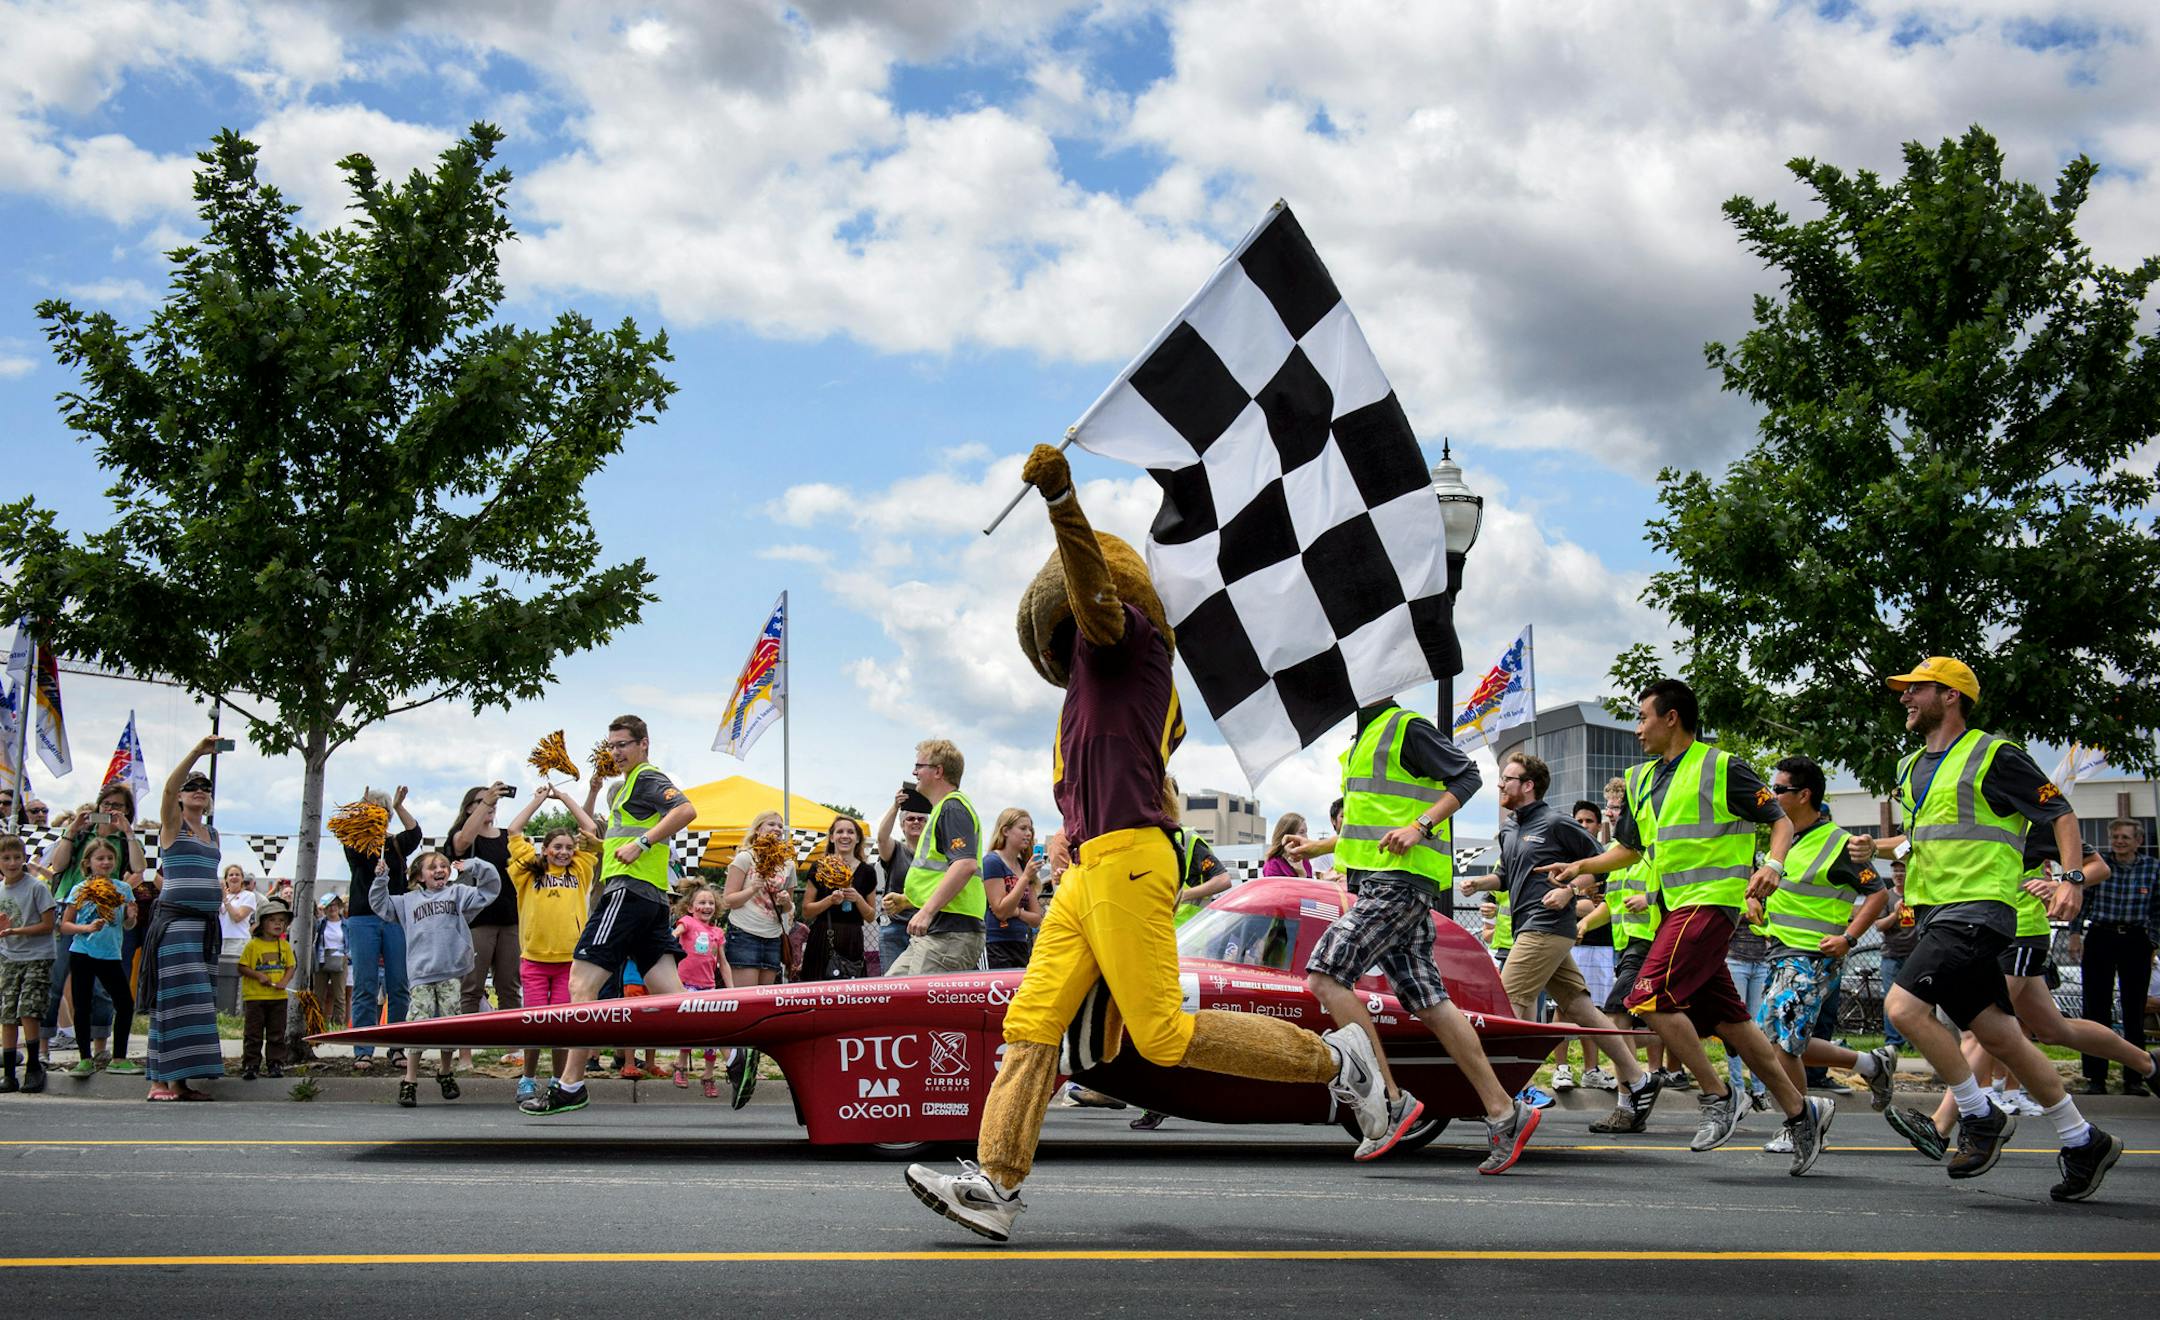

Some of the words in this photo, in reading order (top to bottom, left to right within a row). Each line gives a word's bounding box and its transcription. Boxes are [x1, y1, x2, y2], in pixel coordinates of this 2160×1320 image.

[844, 982, 911, 992] MINNESOTA
[927, 989, 985, 1004] Science
[987, 980, 1010, 1006] &
[678, 999, 740, 1013] Altium
[775, 995, 816, 1007] Driven
[820, 994, 833, 1006] to
[837, 993, 892, 1006] Discover
[521, 1007, 632, 1024] SUNPOWER
[1212, 1002, 1242, 1011] sam
[1248, 1001, 1303, 1018] lenius
[1380, 1014, 1398, 1025] Mills
[837, 1034, 919, 1072] PTC
[858, 1078, 900, 1098] PAR
[925, 1077, 970, 1086] CIRRUS
